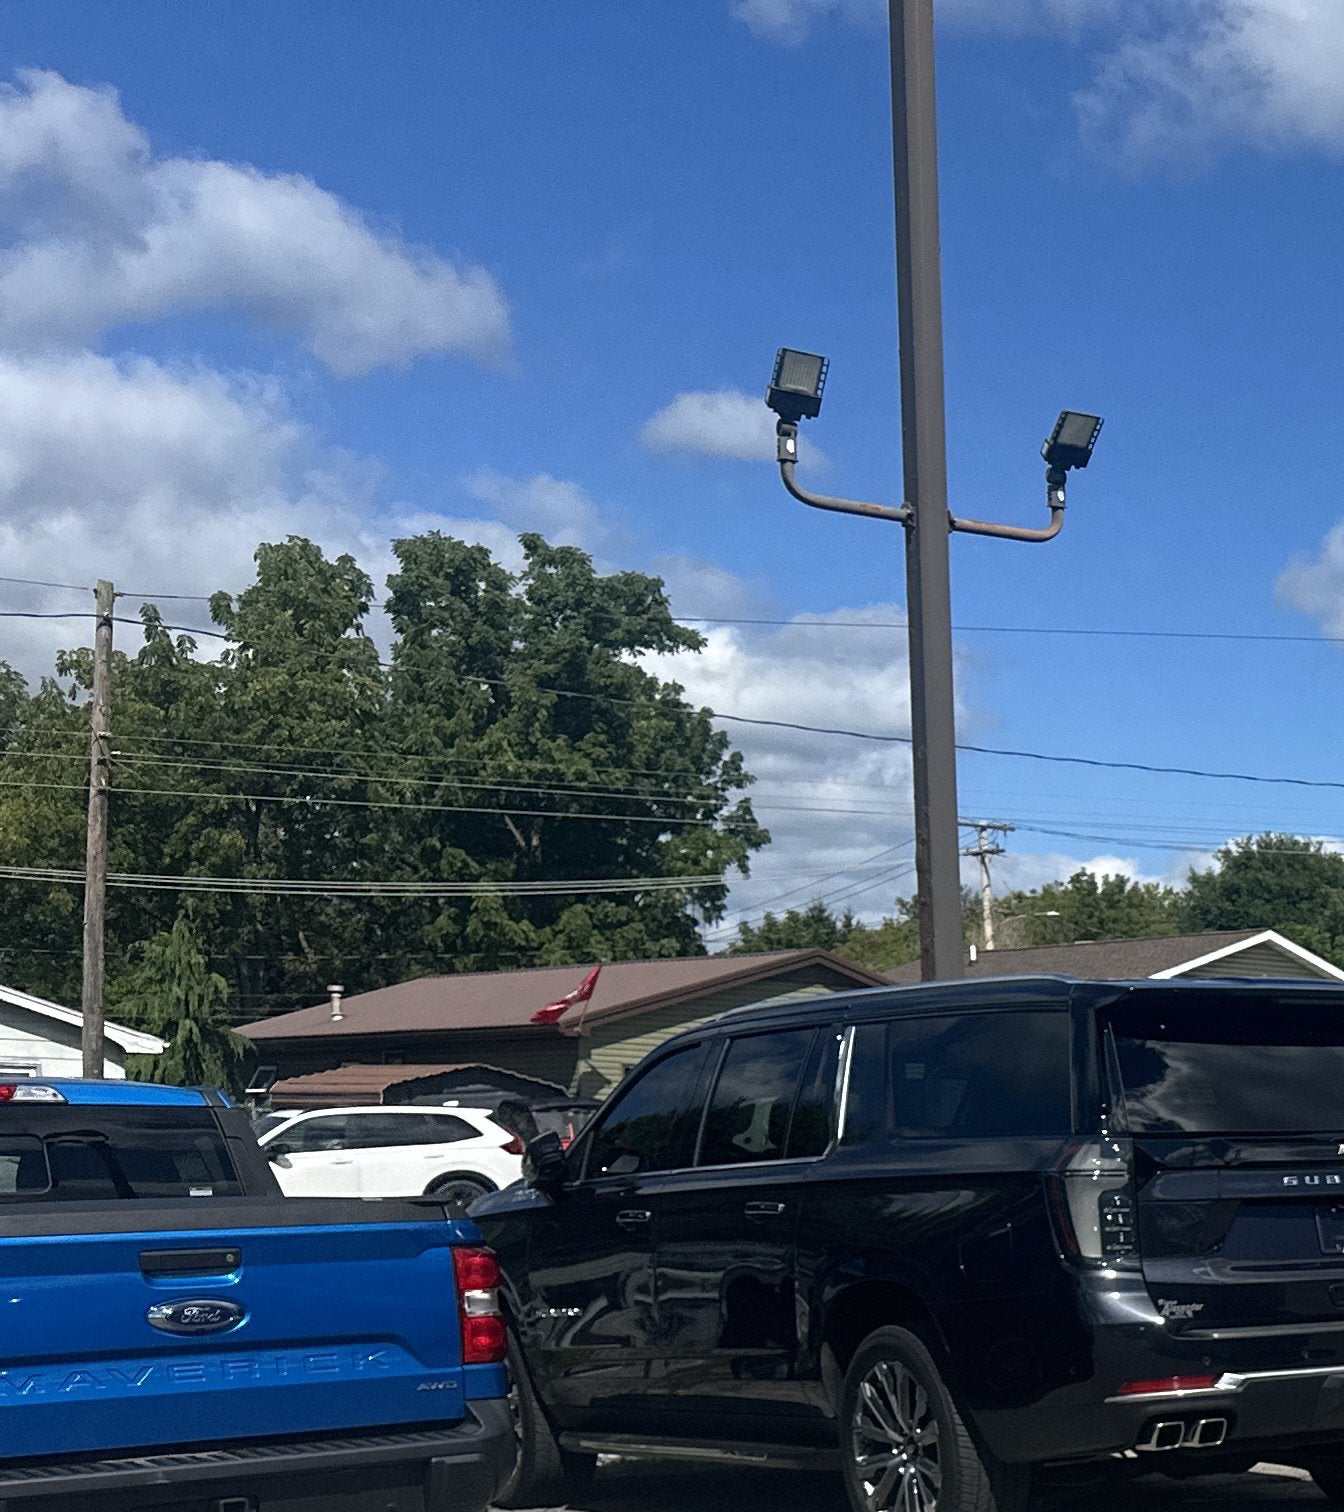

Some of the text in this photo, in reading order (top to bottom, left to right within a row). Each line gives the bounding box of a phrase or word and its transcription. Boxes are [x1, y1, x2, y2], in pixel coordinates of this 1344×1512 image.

[180, 1306, 221, 1323] Ford
[0, 1351, 392, 1396] MAVERICK
[416, 1381, 458, 1391] AWD
